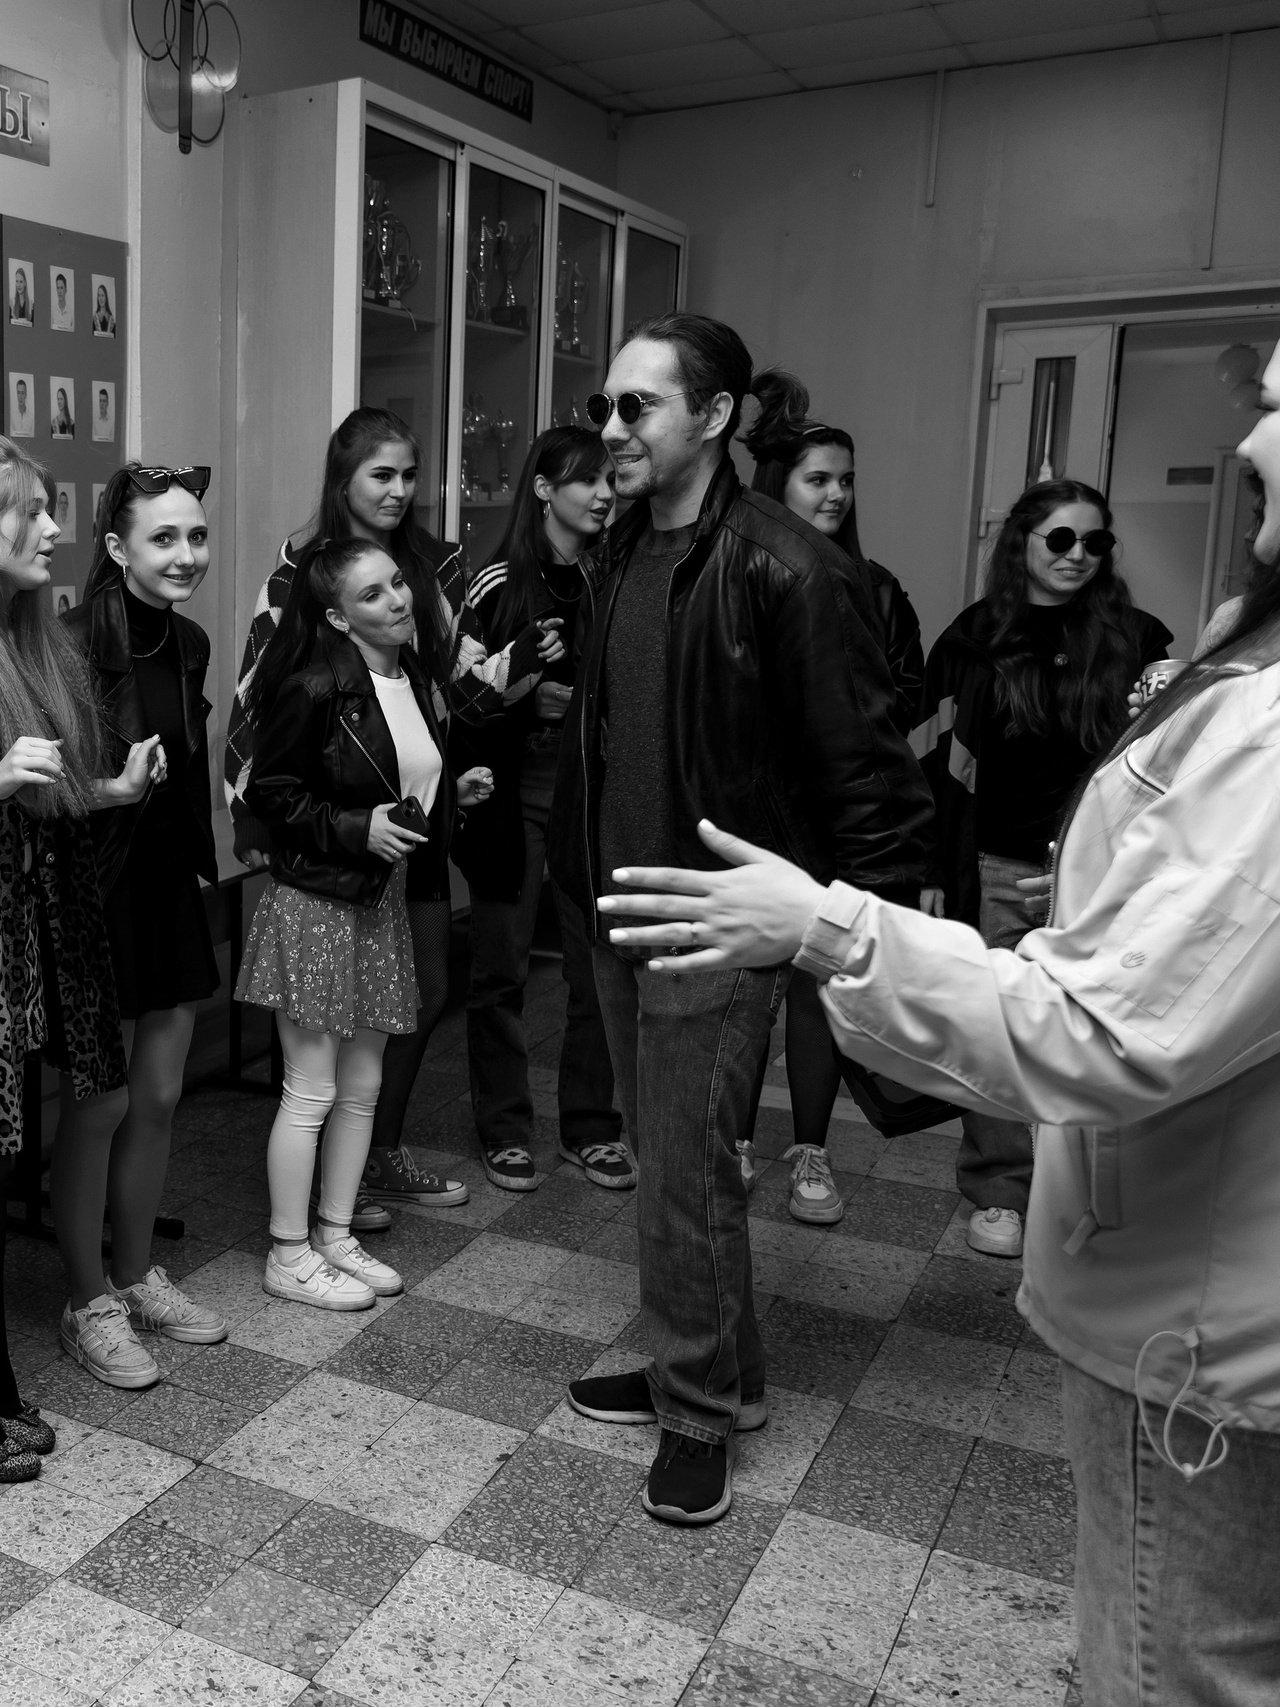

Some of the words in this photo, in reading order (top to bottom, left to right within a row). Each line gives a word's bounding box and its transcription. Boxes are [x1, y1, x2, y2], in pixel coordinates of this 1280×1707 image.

[363, 1, 397, 46] МЫ
[399, 17, 482, 89] ВЫБИРАЕМ
[483, 63, 532, 114] СПОРТ!
